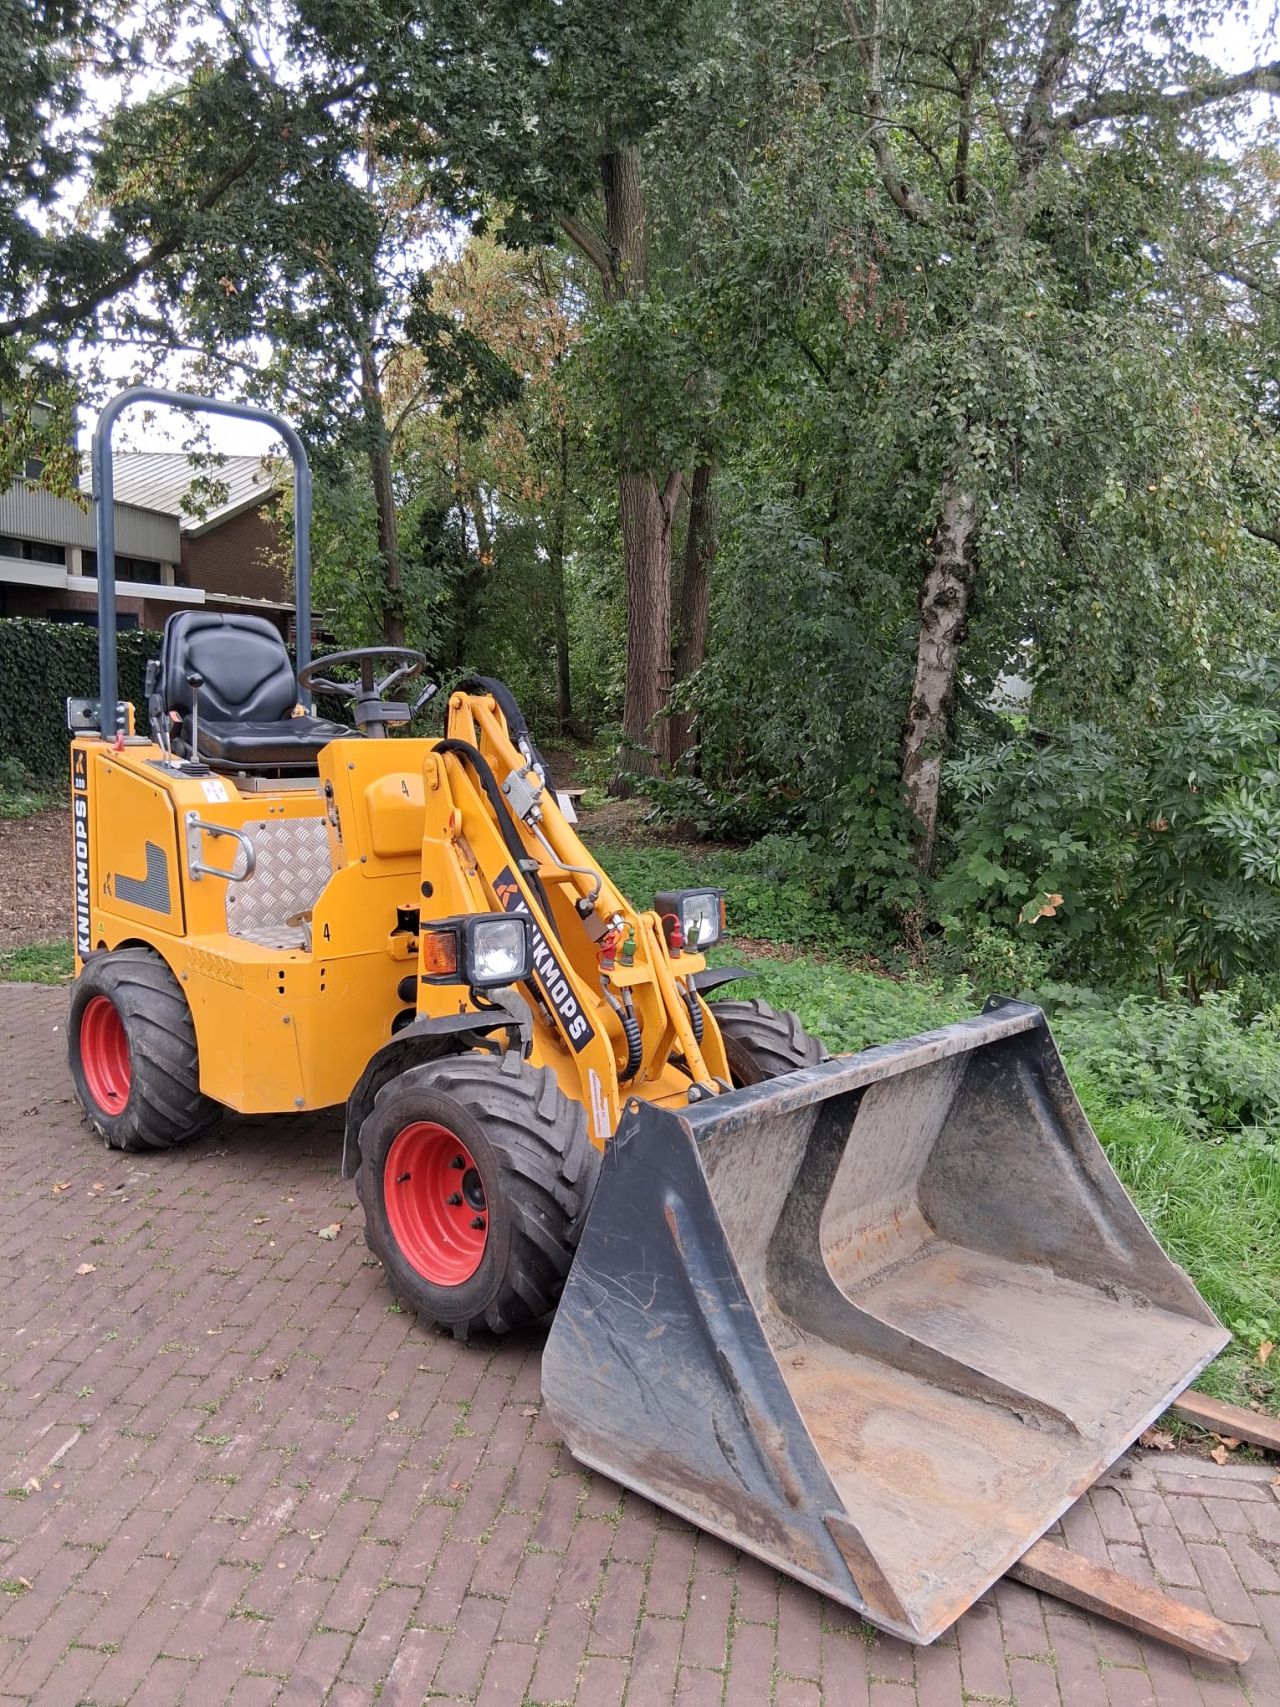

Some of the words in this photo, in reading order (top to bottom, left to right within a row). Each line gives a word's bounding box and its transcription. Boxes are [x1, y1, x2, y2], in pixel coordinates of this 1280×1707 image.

[401, 780, 409, 797] 4
[75, 799, 90, 954] KNIKMOPS
[323, 923, 330, 941] 4
[513, 900, 587, 1040] KIKMOPS
